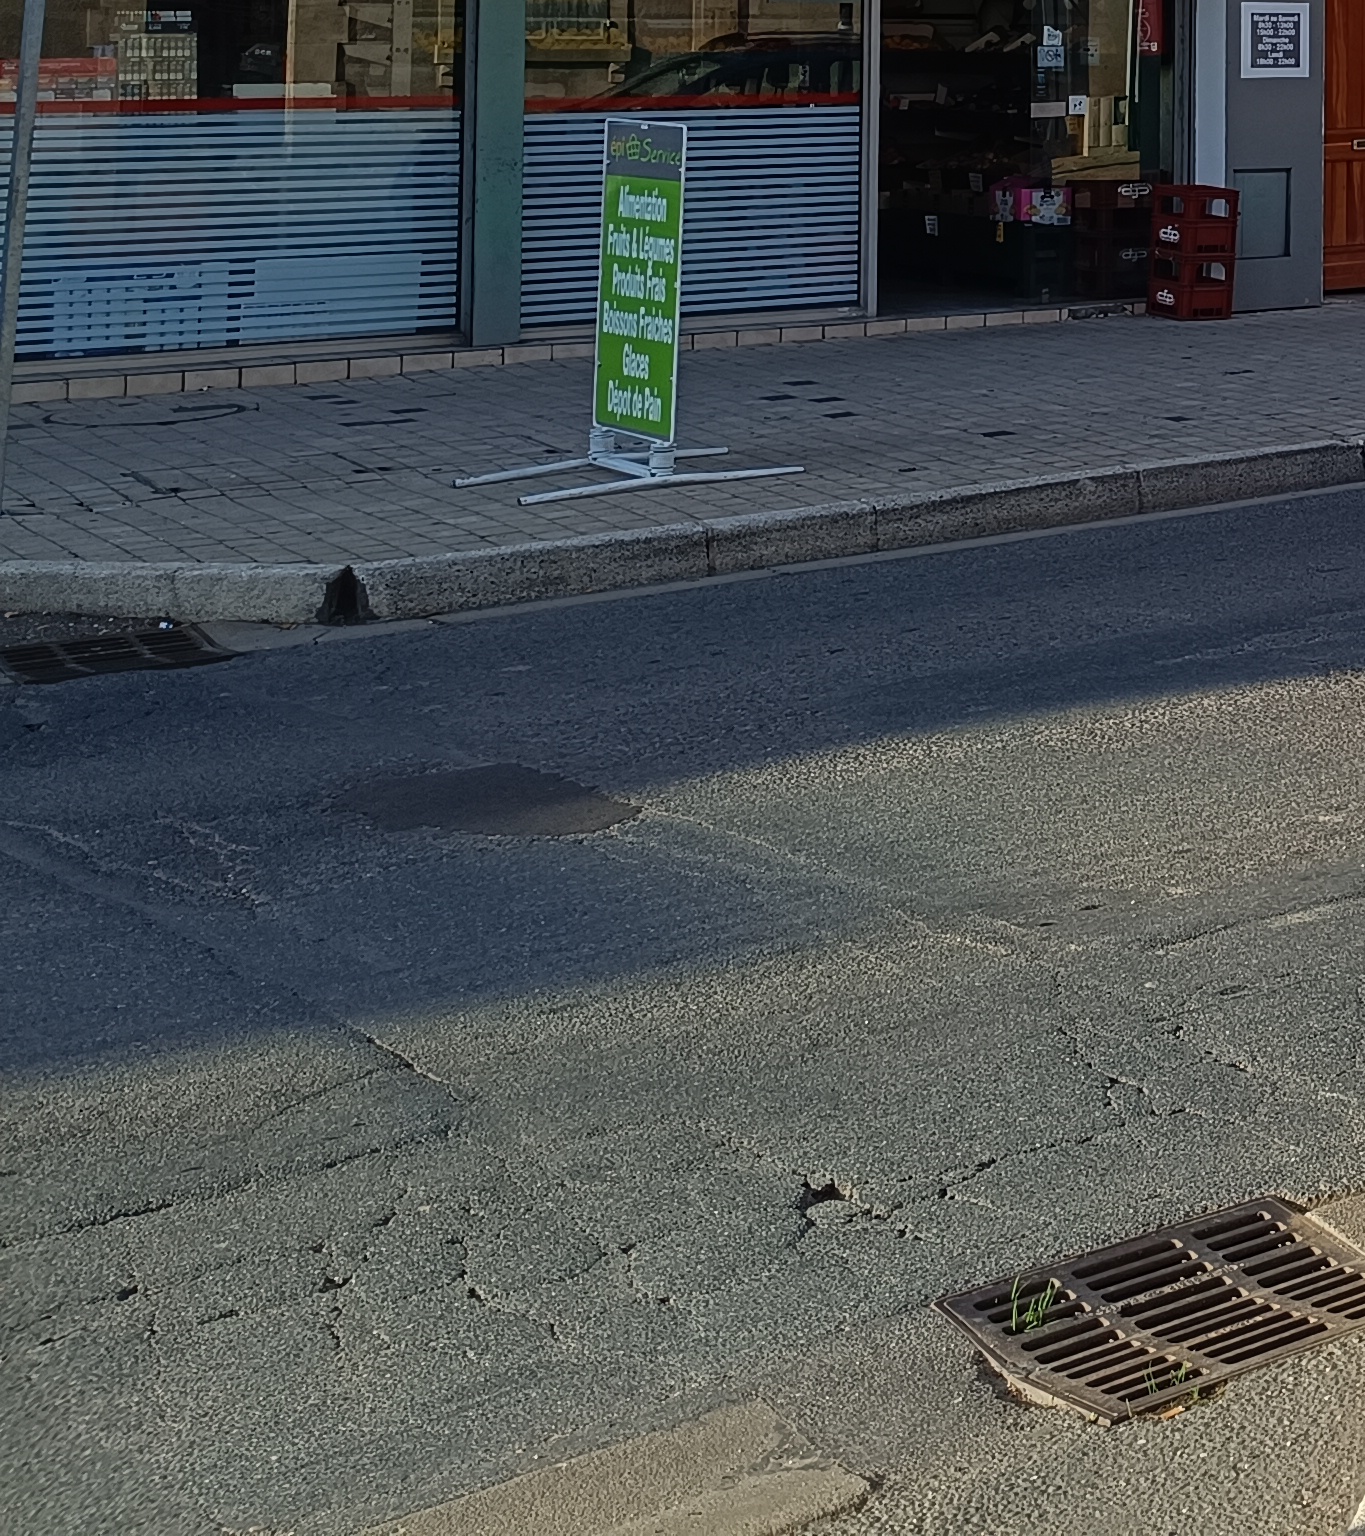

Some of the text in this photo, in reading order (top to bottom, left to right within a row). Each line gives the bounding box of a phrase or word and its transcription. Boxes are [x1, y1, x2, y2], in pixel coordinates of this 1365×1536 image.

[610, 135, 682, 165] épi Service
[617, 184, 667, 223] Alimentation
[606, 224, 675, 265] Fruits & Légumes
[611, 263, 666, 303] Produits Frais
[602, 300, 638, 339] Boissons
[622, 343, 649, 380] Glaces
[632, 386, 642, 417] de
[643, 387, 662, 423] Pain
